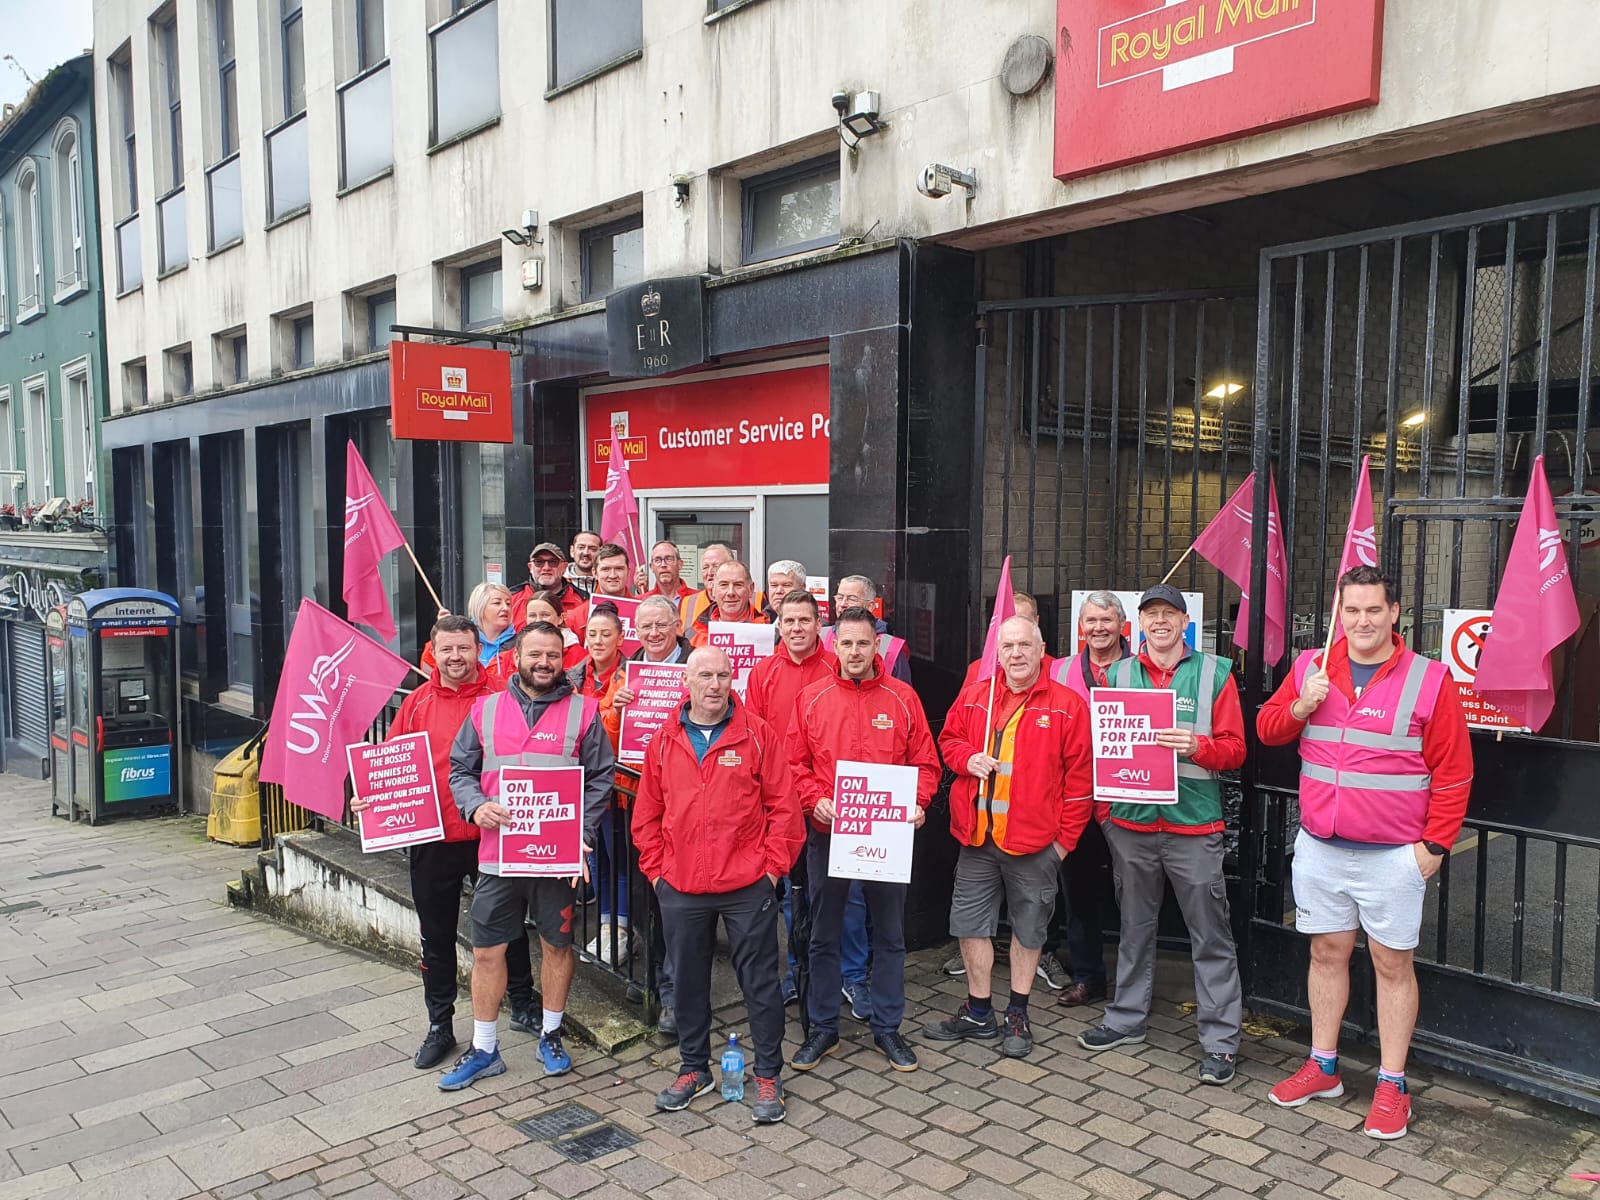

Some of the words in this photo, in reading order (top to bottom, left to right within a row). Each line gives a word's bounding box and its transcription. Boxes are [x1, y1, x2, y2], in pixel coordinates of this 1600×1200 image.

[1110, 5, 1205, 67] Royal
[637, 324, 645, 350] E
[660, 320, 671, 347] R
[643, 354, 668, 369] 1960
[421, 392, 457, 408] Royal
[460, 394, 488, 408] Mail
[659, 425, 733, 449] Customer
[739, 416, 803, 444] Service
[624, 440, 643, 455] Mail
[115, 607, 156, 616] Internet
[713, 635, 731, 645] ON
[721, 646, 751, 656] TRIKE
[638, 668, 672, 678] MILLIONS
[656, 679, 680, 688] BOSSES
[638, 690, 668, 699] PENNIES
[669, 691, 682, 699] FOR
[1459, 687, 1473, 696] No
[627, 710, 654, 719] SUPPORT
[655, 712, 669, 720] OUR
[1098, 704, 1119, 715] ON
[1099, 718, 1145, 729] STRIKE
[1481, 714, 1509, 724] point
[1100, 731, 1126, 742] FOR
[362, 743, 400, 759] MILLIONS
[401, 741, 416, 752] FOR
[1101, 745, 1128, 756] PAY
[370, 758, 384, 768] THE
[384, 752, 411, 765] BOSSES
[120, 768, 155, 783] fibrus
[368, 767, 402, 781] PENNIES
[402, 764, 417, 775] FOR
[370, 780, 384, 791] THE
[384, 773, 419, 788] WORKERS
[506, 782, 528, 793] ON
[840, 778, 863, 790] ON
[393, 787, 408, 799] OUR
[408, 785, 432, 796] STRIKE
[507, 795, 554, 807] STRIKE
[840, 793, 888, 806] STRIKE
[509, 808, 534, 819] FOR
[538, 807, 569, 819] FAIR
[840, 806, 868, 819] FOR
[870, 807, 901, 820] FAIR
[509, 821, 535, 832] PAY
[840, 820, 867, 833] PAY
